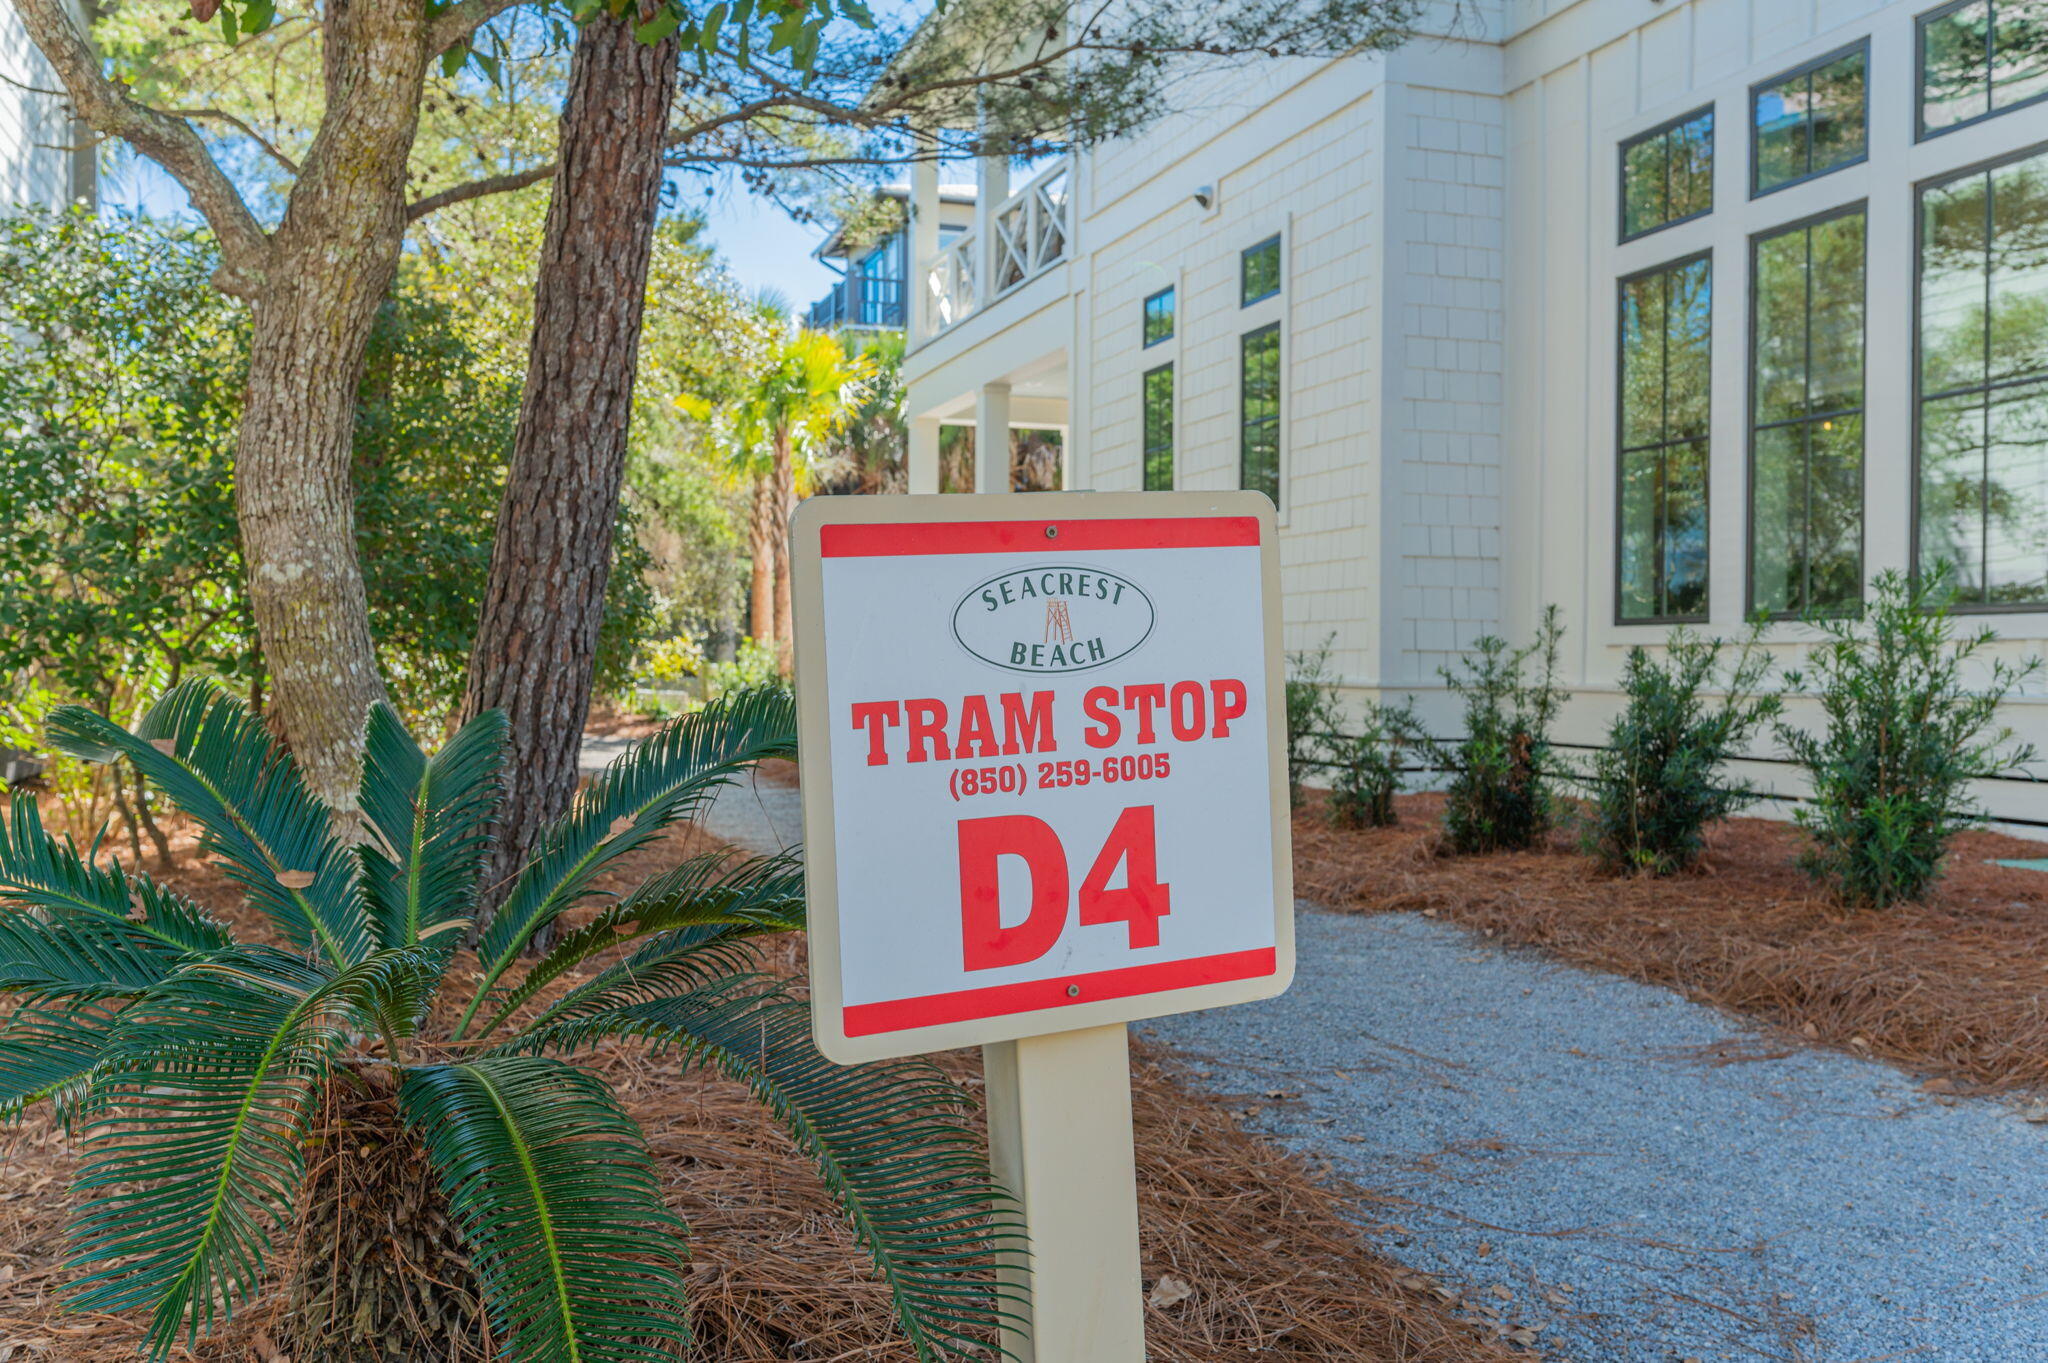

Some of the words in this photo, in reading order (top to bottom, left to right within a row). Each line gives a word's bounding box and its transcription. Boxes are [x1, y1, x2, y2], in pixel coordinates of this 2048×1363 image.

[981, 573, 1126, 612] SEACREST
[1010, 637, 1105, 667] BEACH
[851, 690, 1058, 766] TRAM
[1083, 678, 1248, 749] STOP
[949, 763, 1028, 801] (850)
[1038, 752, 1171, 789] 259-6005
[957, 805, 1171, 973] D4
